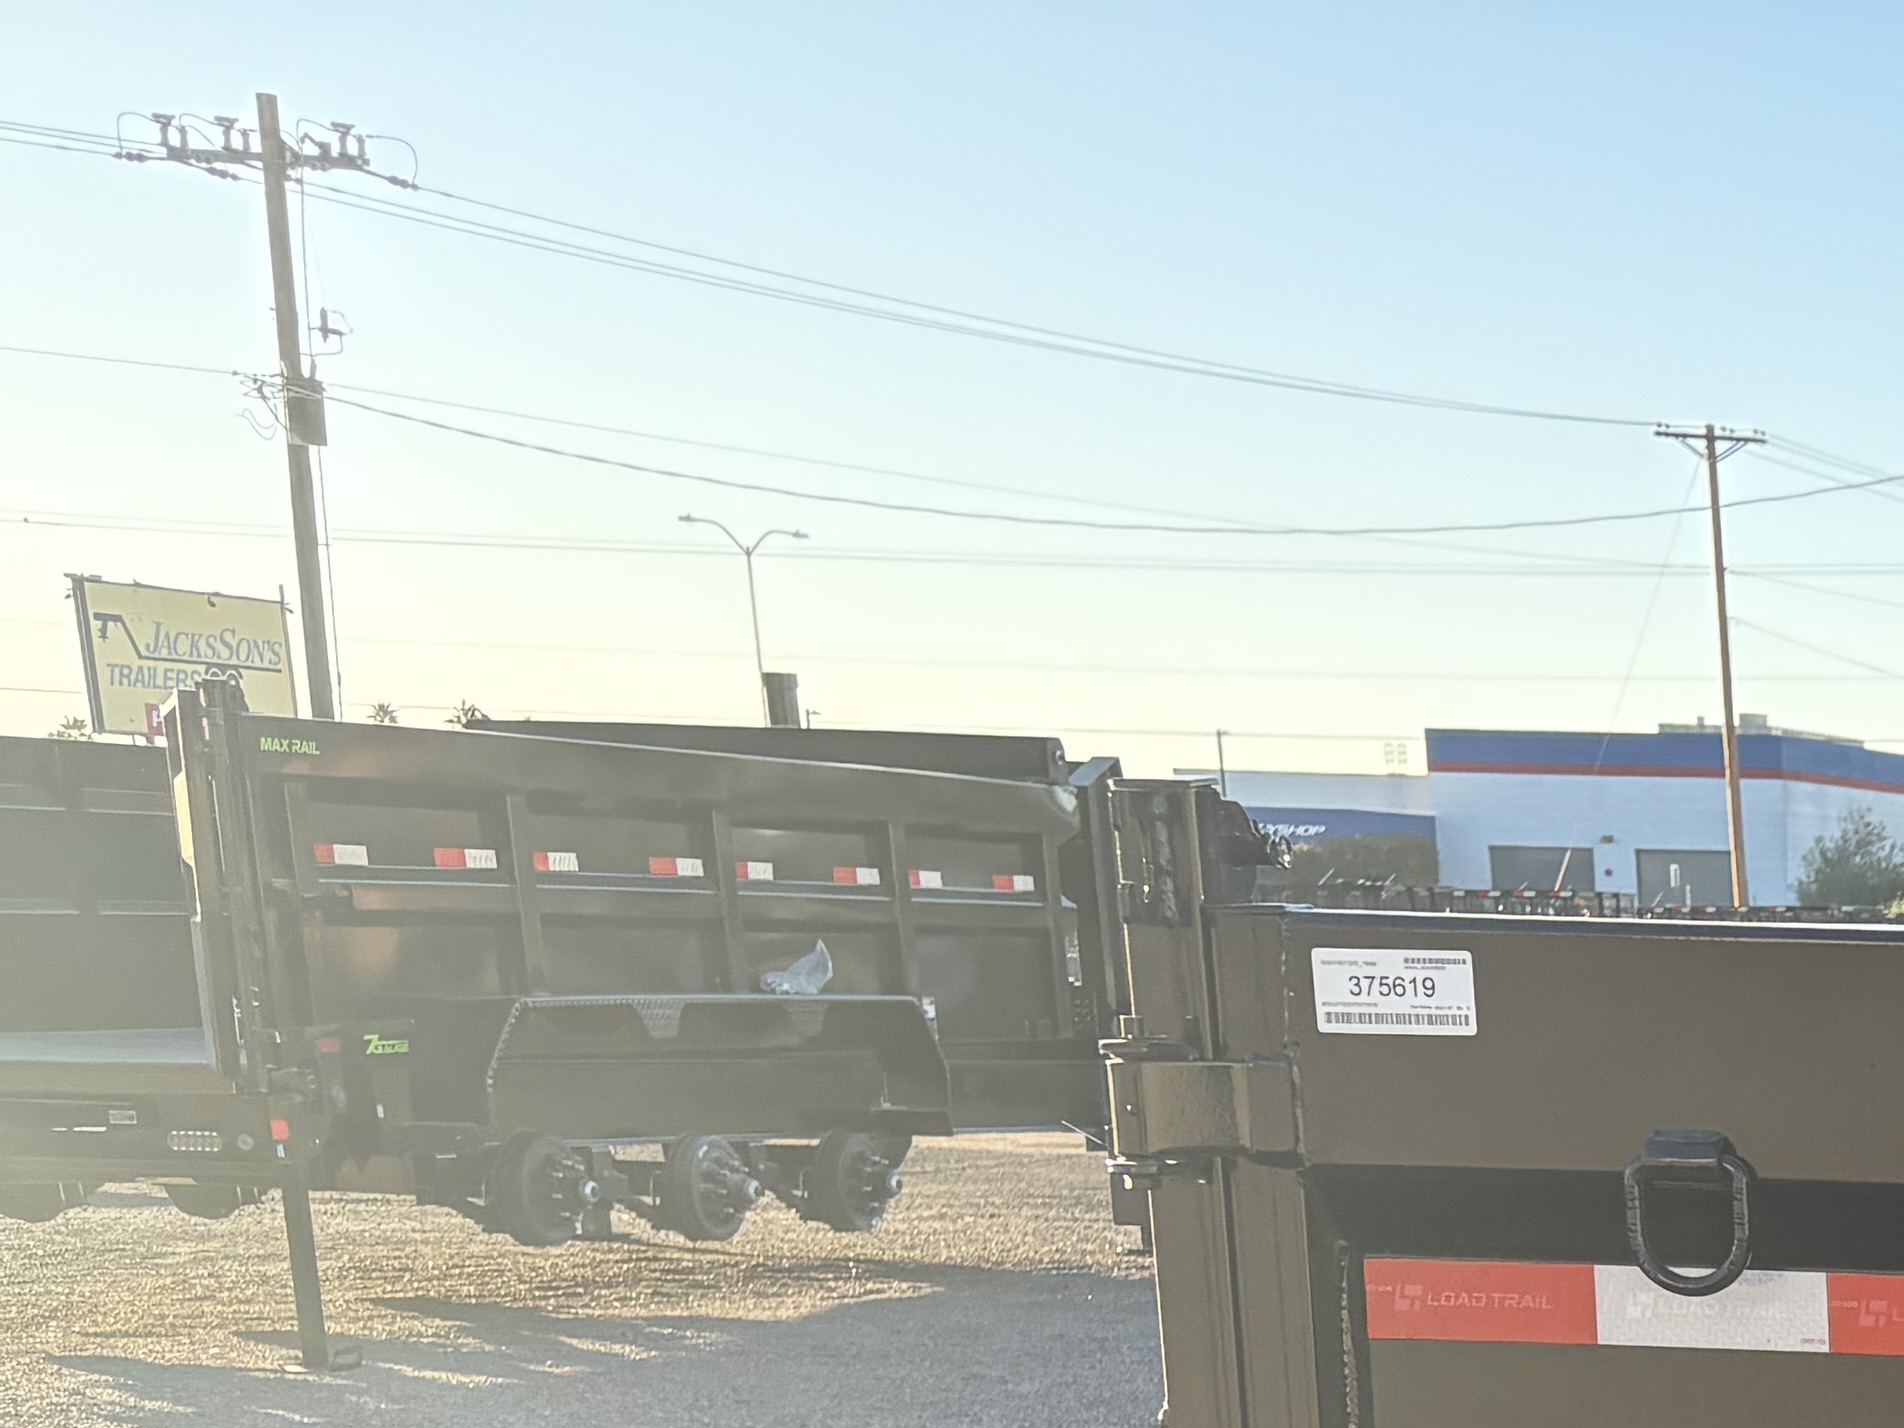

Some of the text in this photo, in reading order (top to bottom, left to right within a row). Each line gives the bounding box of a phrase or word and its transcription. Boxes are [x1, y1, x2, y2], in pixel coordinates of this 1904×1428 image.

[260, 737, 320, 755] MAX RAIL
[1348, 975, 1437, 998] 375619
[1427, 1291, 1552, 1310] LOAD TRAIL
